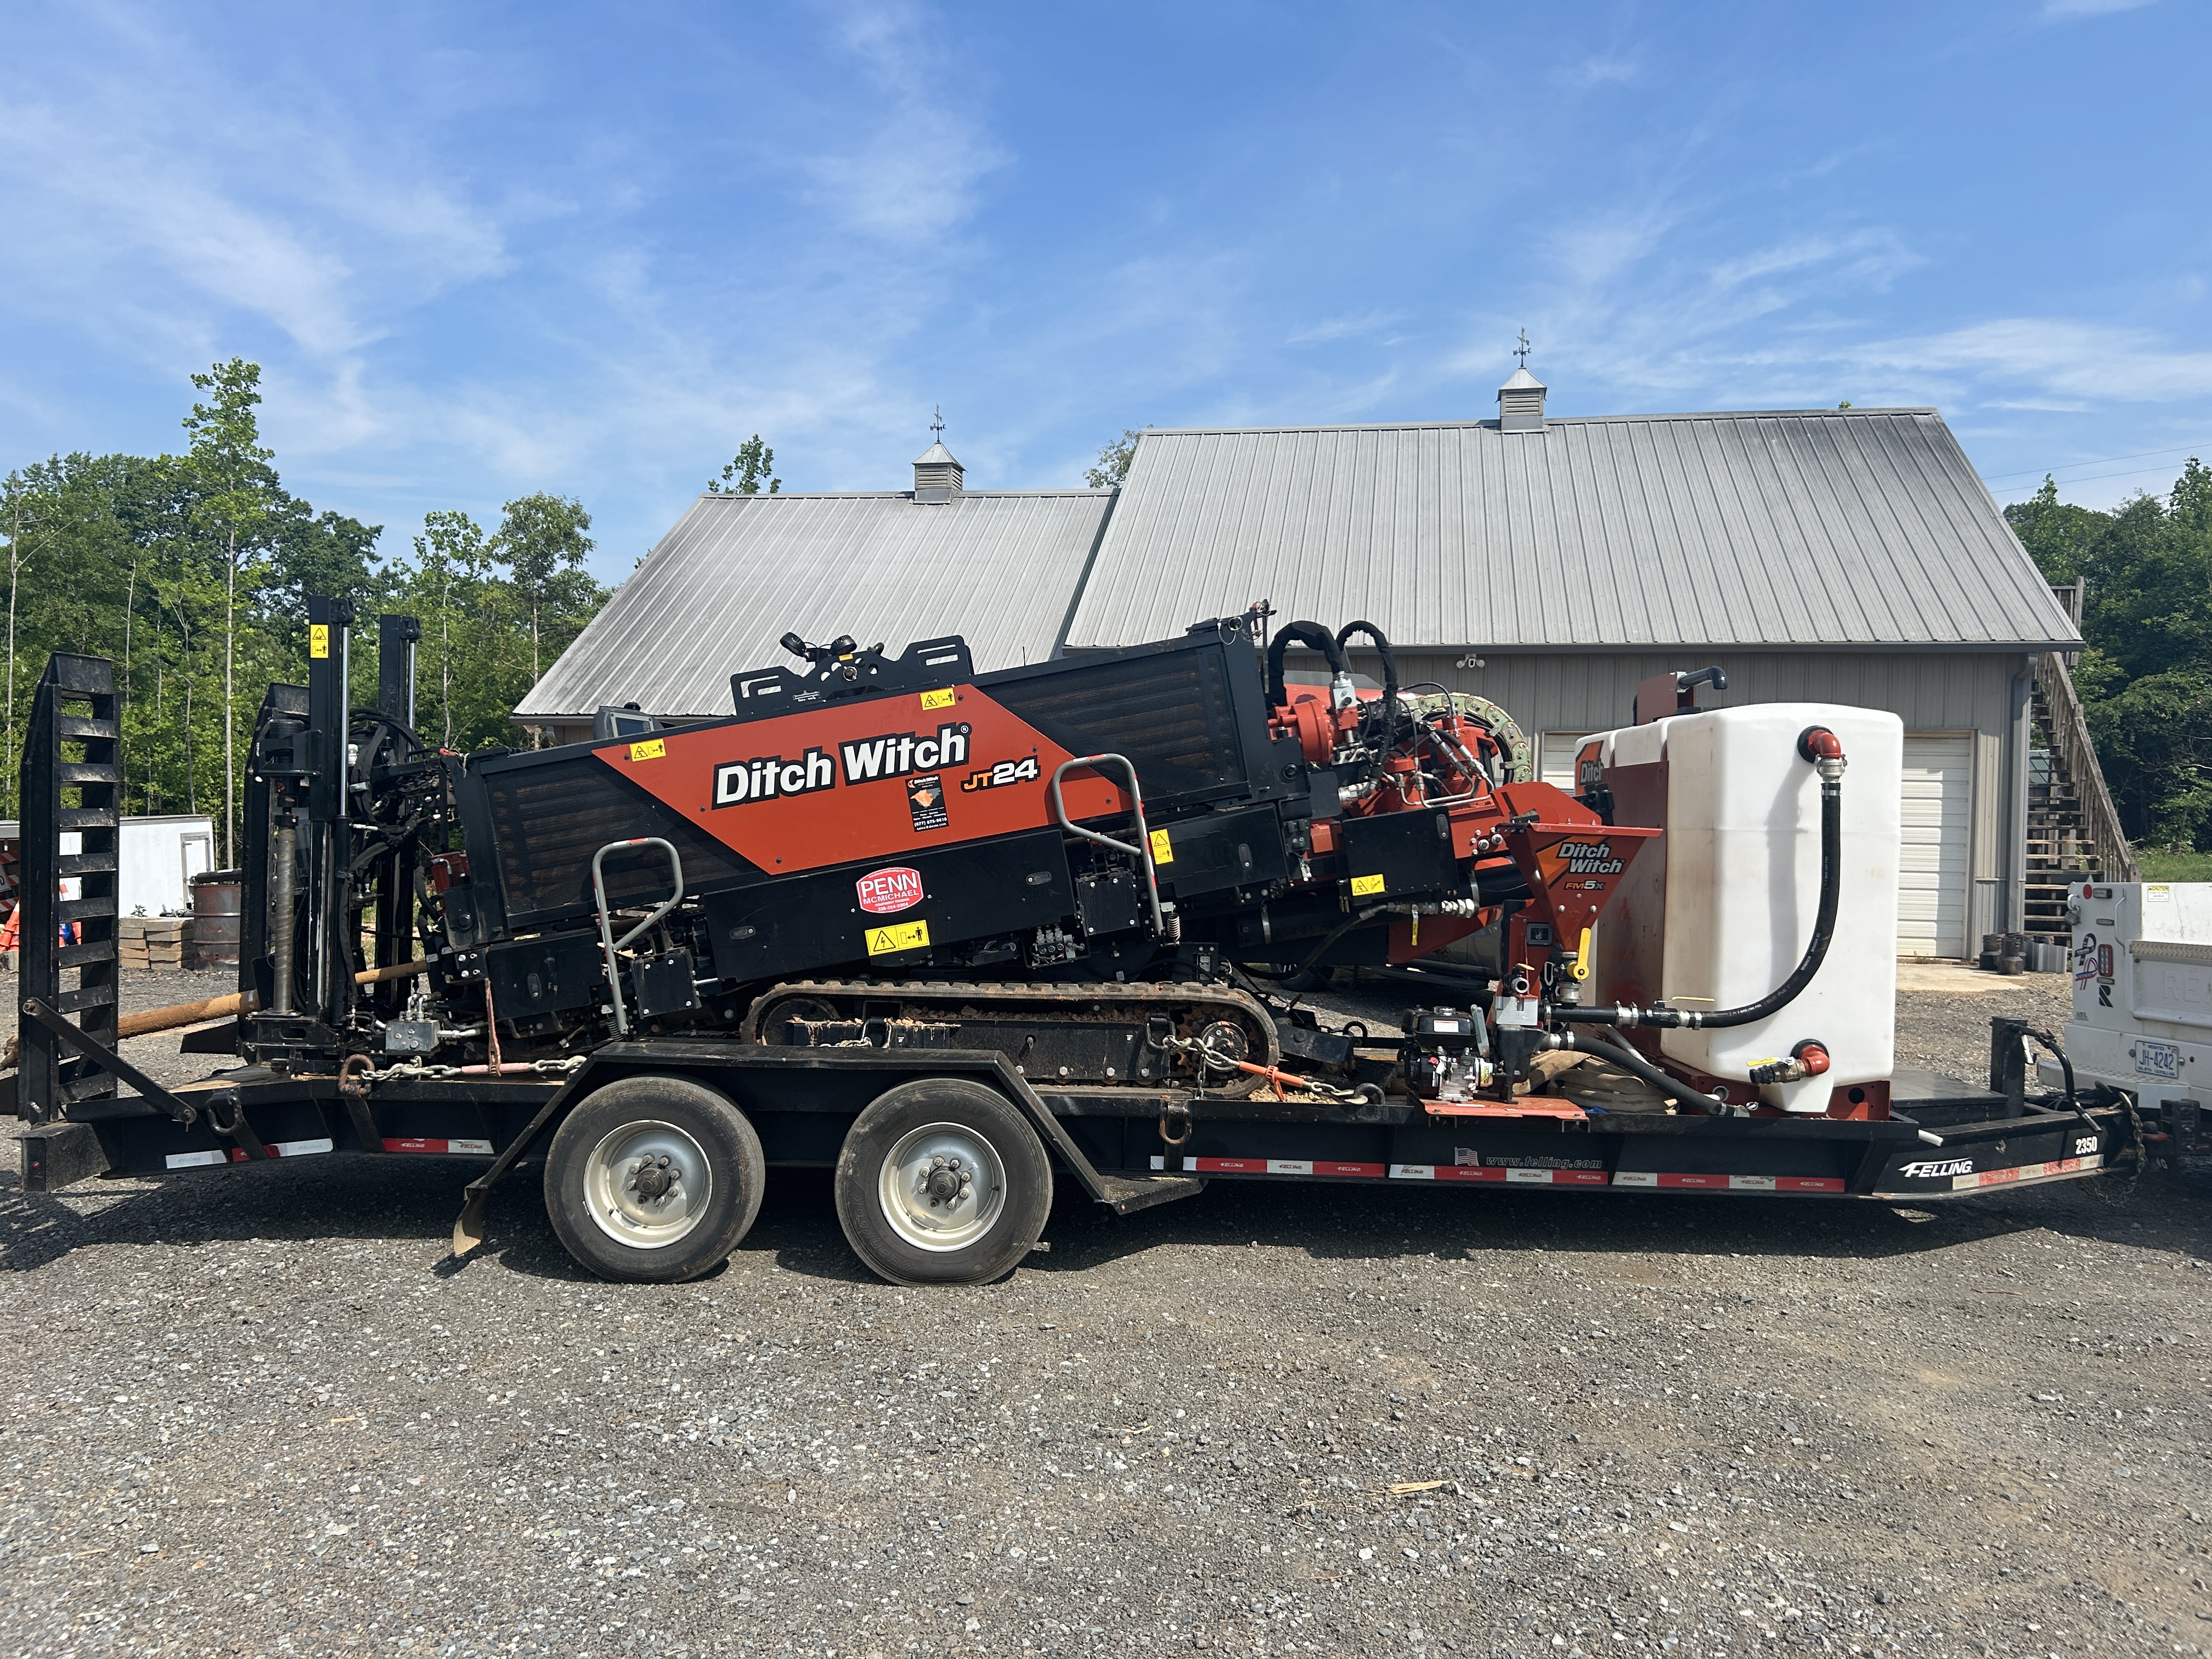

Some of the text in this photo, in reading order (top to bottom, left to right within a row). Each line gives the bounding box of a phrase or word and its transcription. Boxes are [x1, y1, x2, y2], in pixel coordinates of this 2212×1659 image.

[716, 752, 832, 805] Ditch
[963, 759, 1038, 790] JT24
[1558, 843, 1610, 857] Ditch
[860, 872, 918, 898] PENN
[863, 889, 919, 905] MCMICHAEL
[2140, 1049, 2174, 1070] JH-4242
[2075, 1136, 2098, 1155] 2350
[1486, 1155, 1602, 1170] www.felling.com
[1898, 1156, 1973, 1178] FELLING
